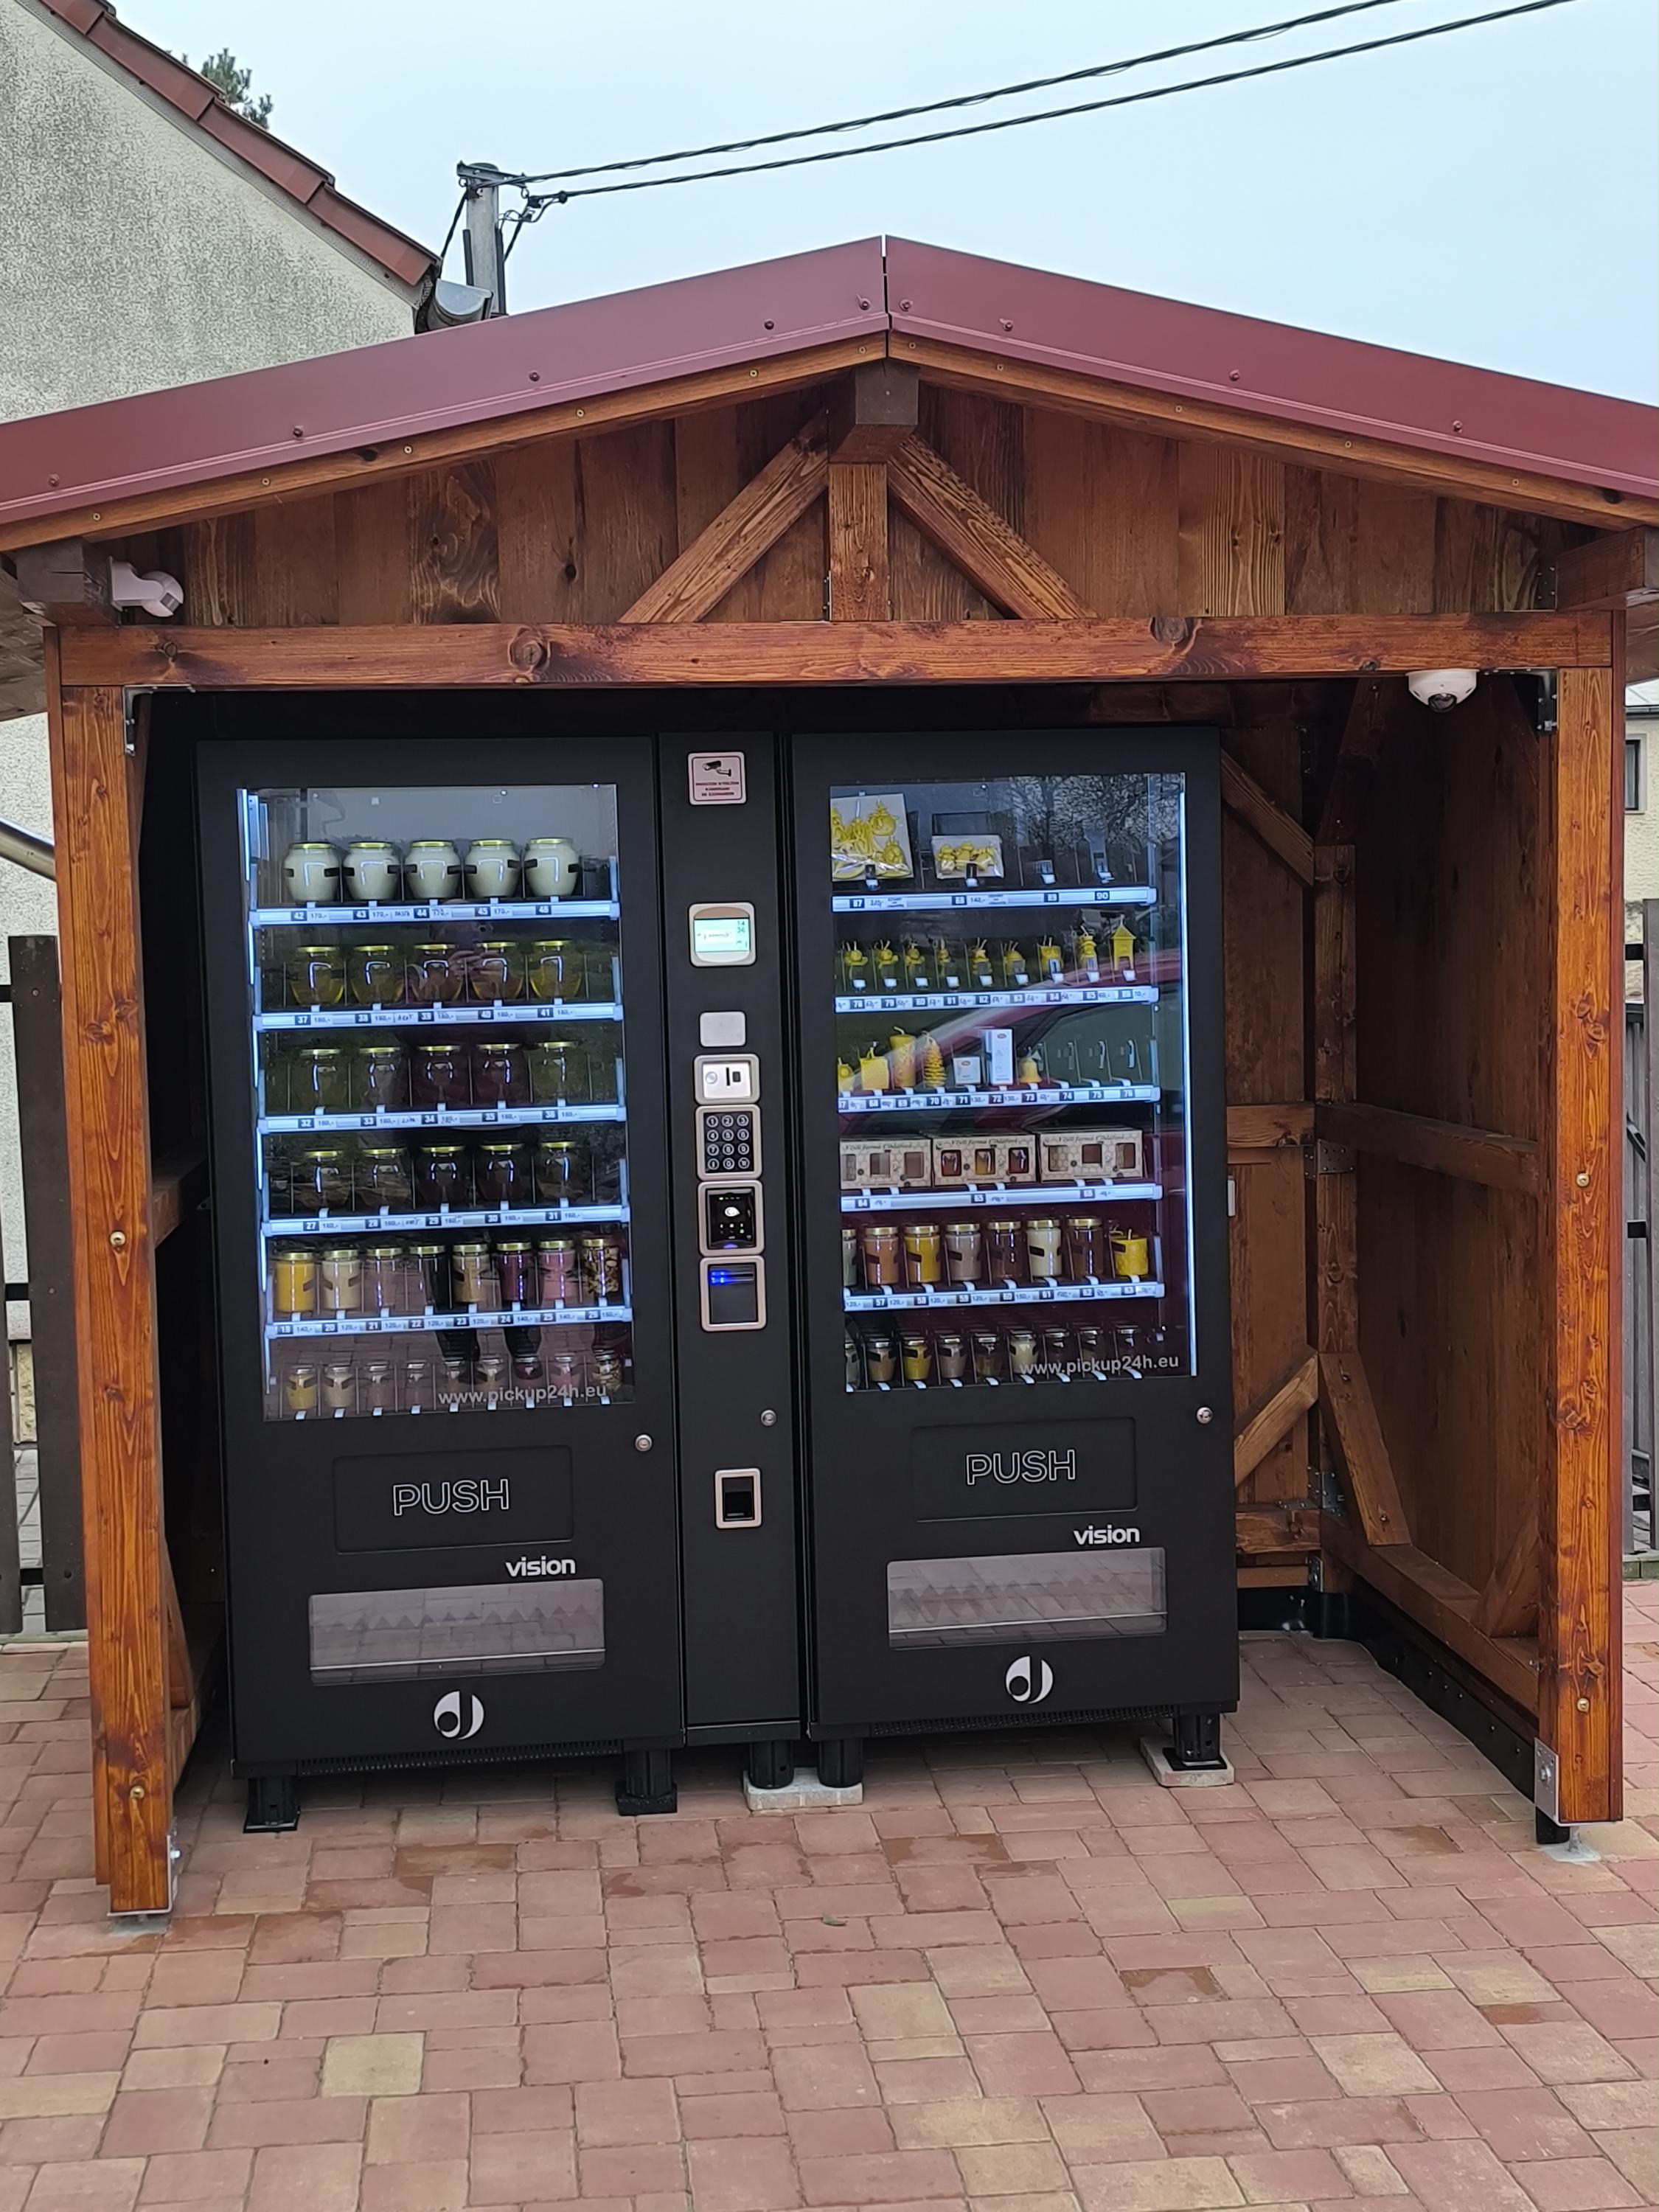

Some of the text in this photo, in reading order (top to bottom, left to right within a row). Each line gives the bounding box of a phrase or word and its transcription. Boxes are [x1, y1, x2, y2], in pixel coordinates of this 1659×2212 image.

[1020, 1354, 1179, 1375] www.pickup24h.eu
[438, 1385, 607, 1405] www.pickup24h.eu
[966, 1449, 1077, 1486] PUSH
[392, 1478, 510, 1516] PUSH
[1073, 1524, 1140, 1545] vision
[505, 1555, 576, 1577] vision
